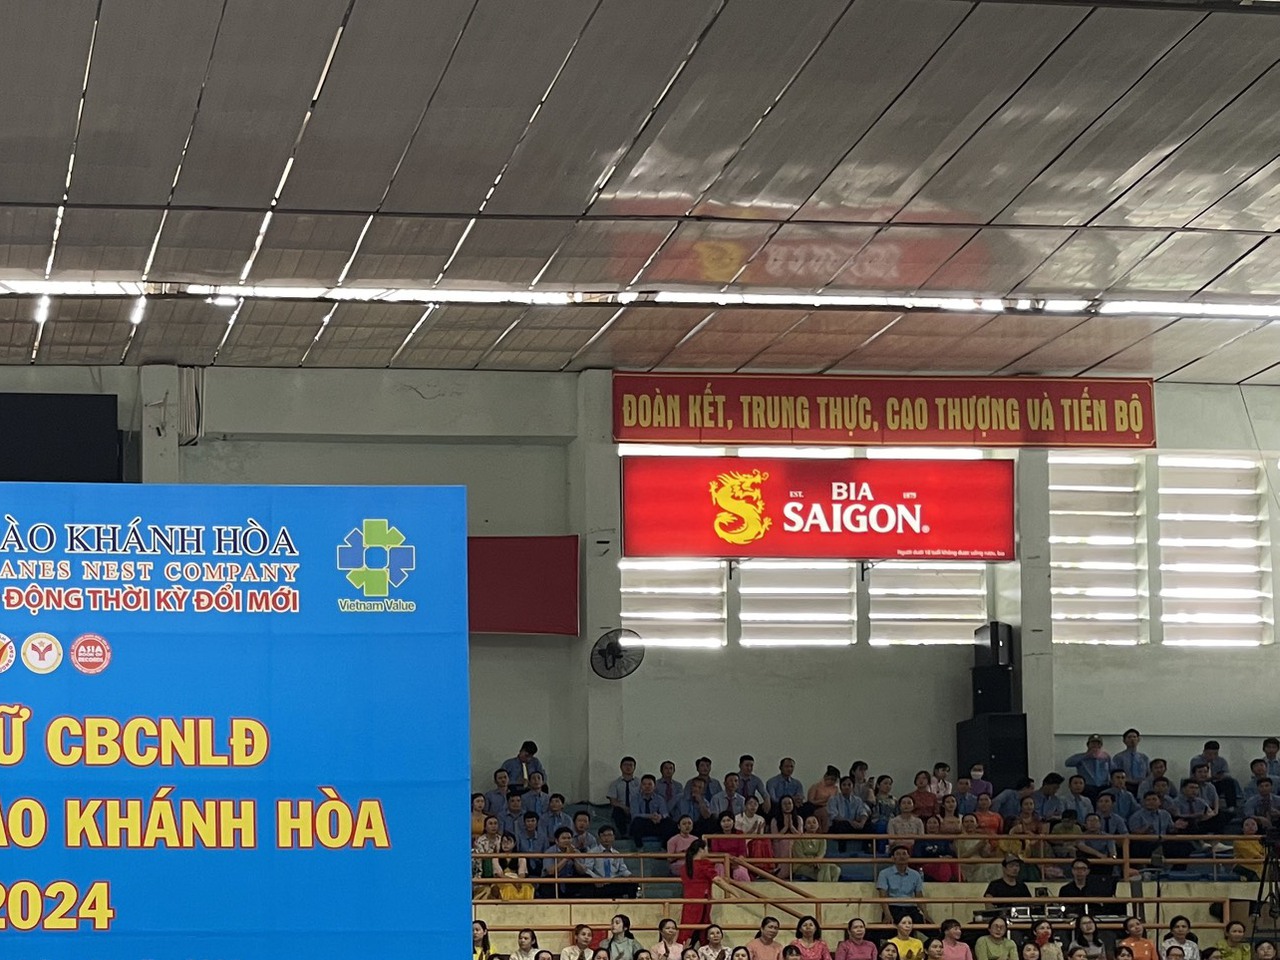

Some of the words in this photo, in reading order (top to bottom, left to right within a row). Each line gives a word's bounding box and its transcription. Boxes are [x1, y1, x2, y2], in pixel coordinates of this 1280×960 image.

[623, 388, 680, 427] ĐOÀN
[689, 382, 733, 430] KẾT,
[740, 396, 810, 429] TRUNG
[816, 394, 879, 436] THỰC,
[886, 397, 928, 431] CAO
[935, 395, 1020, 437] THƯỢNG
[1027, 392, 1055, 431] VÀ
[1061, 387, 1108, 432] TIẾN
[1115, 393, 1143, 439] BỘ
[831, 482, 874, 501] BIA
[782, 501, 922, 534] SAIGON
[65, 516, 205, 555] KHÁNH
[213, 518, 300, 556] HÒA
[82, 561, 153, 580] NEST
[164, 562, 300, 582] COMPANY
[4, 584, 83, 615] ĐỘNG
[86, 584, 150, 612] THỜI
[155, 585, 192, 612] KỲ
[193, 583, 242, 612] ĐỔI
[246, 585, 300, 613] MỚI
[338, 599, 385, 611] Vietnam
[384, 599, 417, 612] Value
[45, 715, 269, 767] CBCNLĐ
[65, 786, 257, 849] KHÁNH
[277, 786, 391, 849] HÒA
